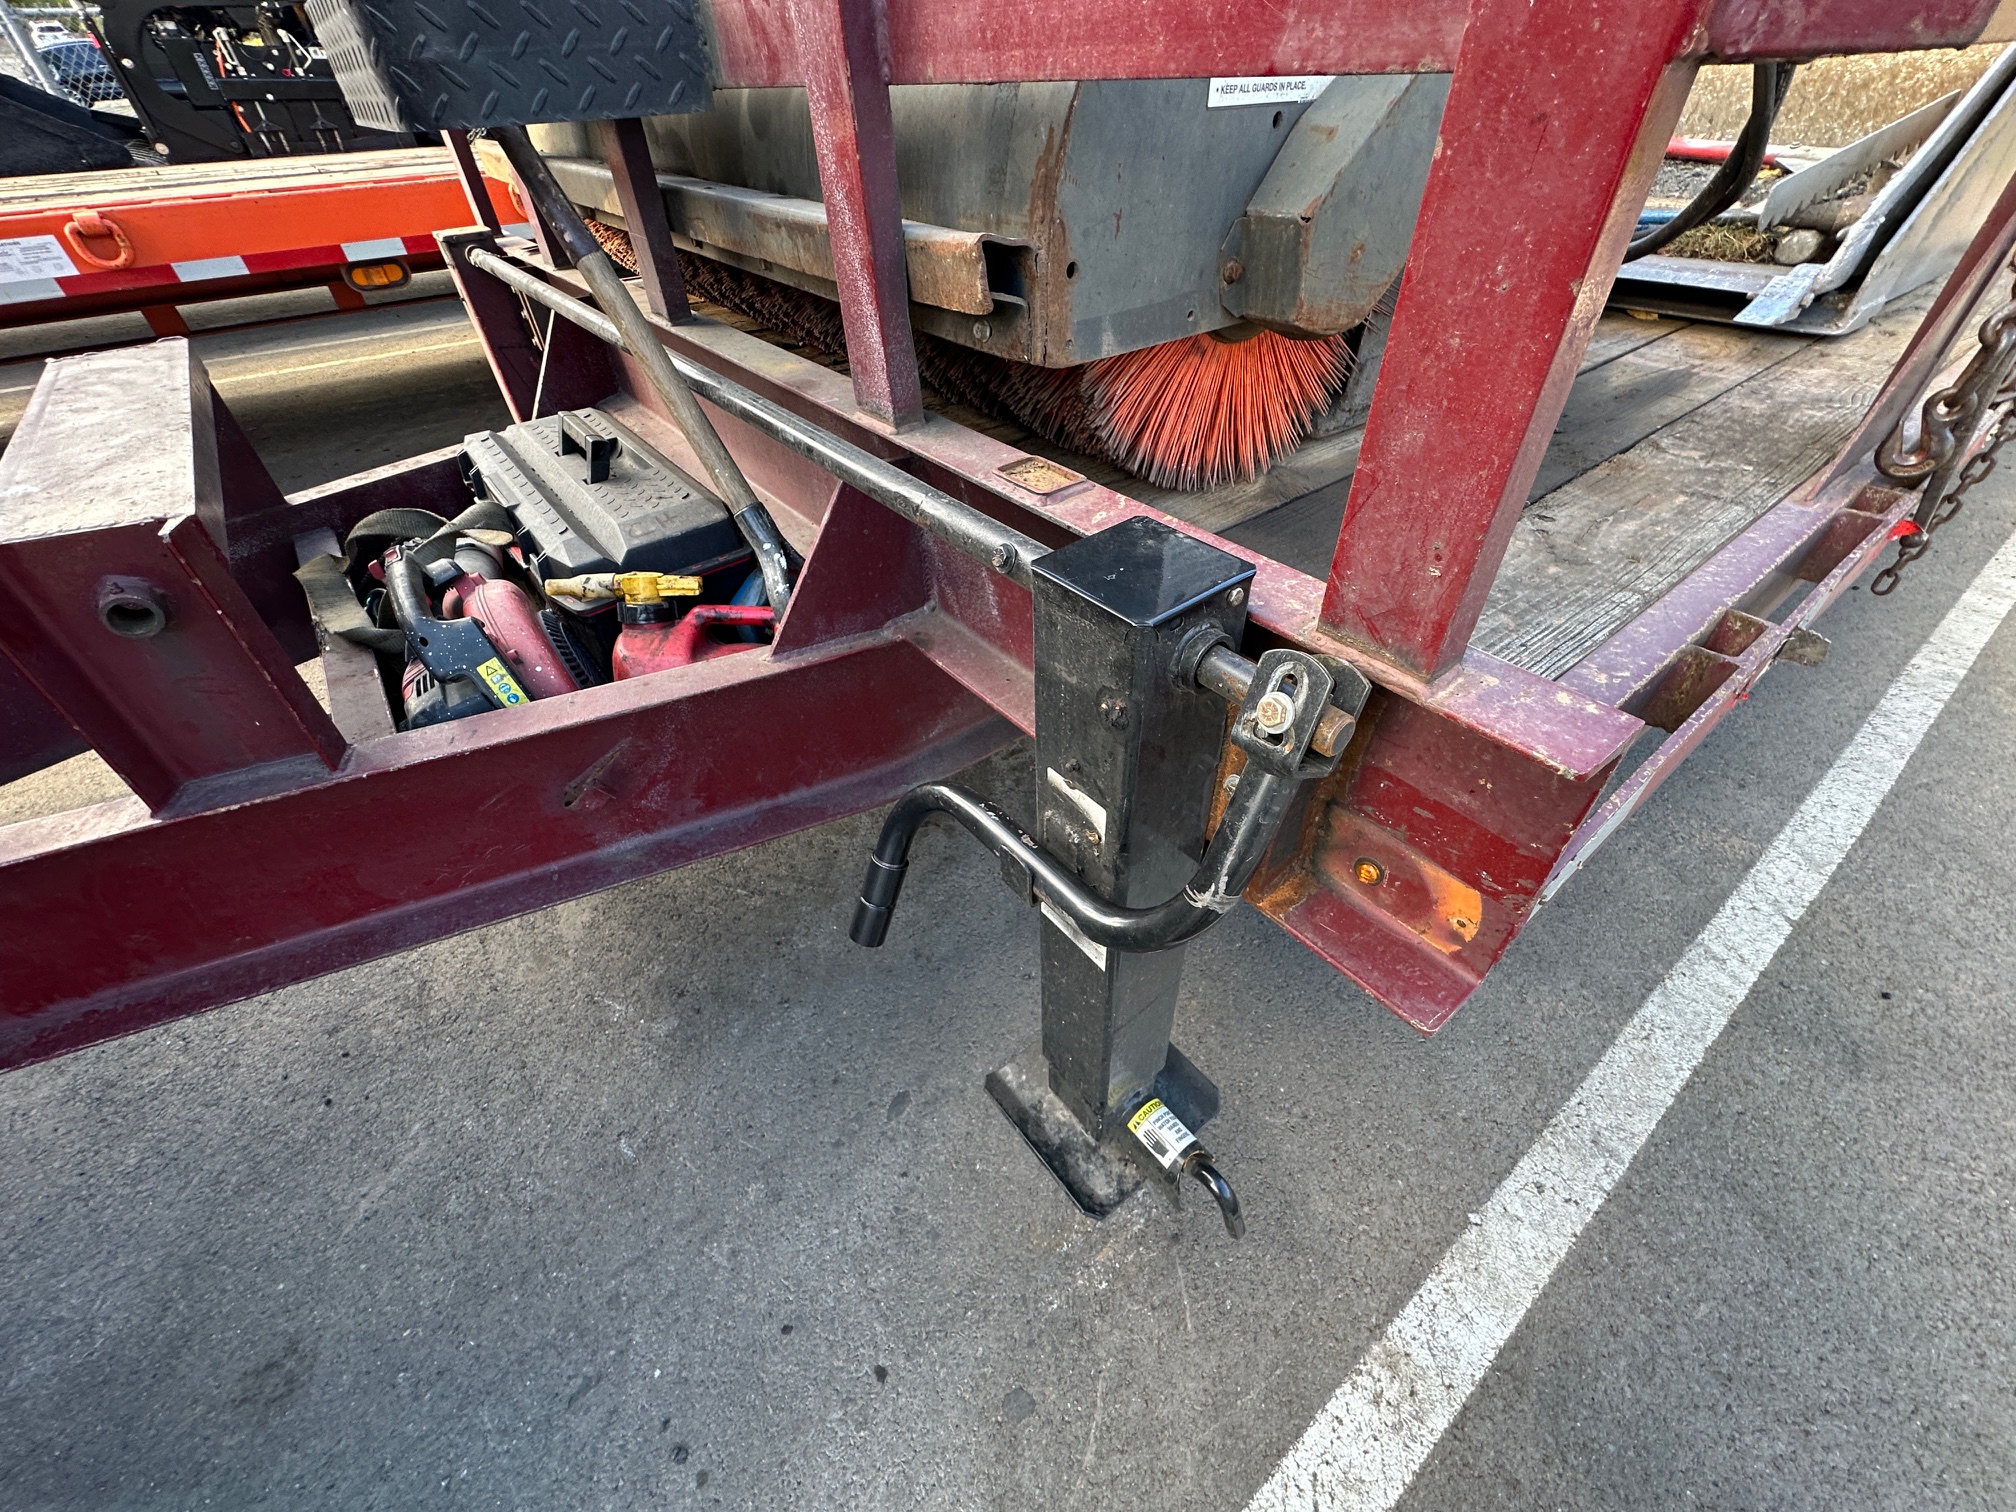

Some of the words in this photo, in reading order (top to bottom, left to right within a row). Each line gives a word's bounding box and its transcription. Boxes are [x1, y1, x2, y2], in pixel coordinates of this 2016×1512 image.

[1220, 84, 1238, 94] KEEP
[1239, 83, 1250, 93] ALL
[1252, 82, 1278, 92] GUARDS
[1278, 82, 1285, 91] IN
